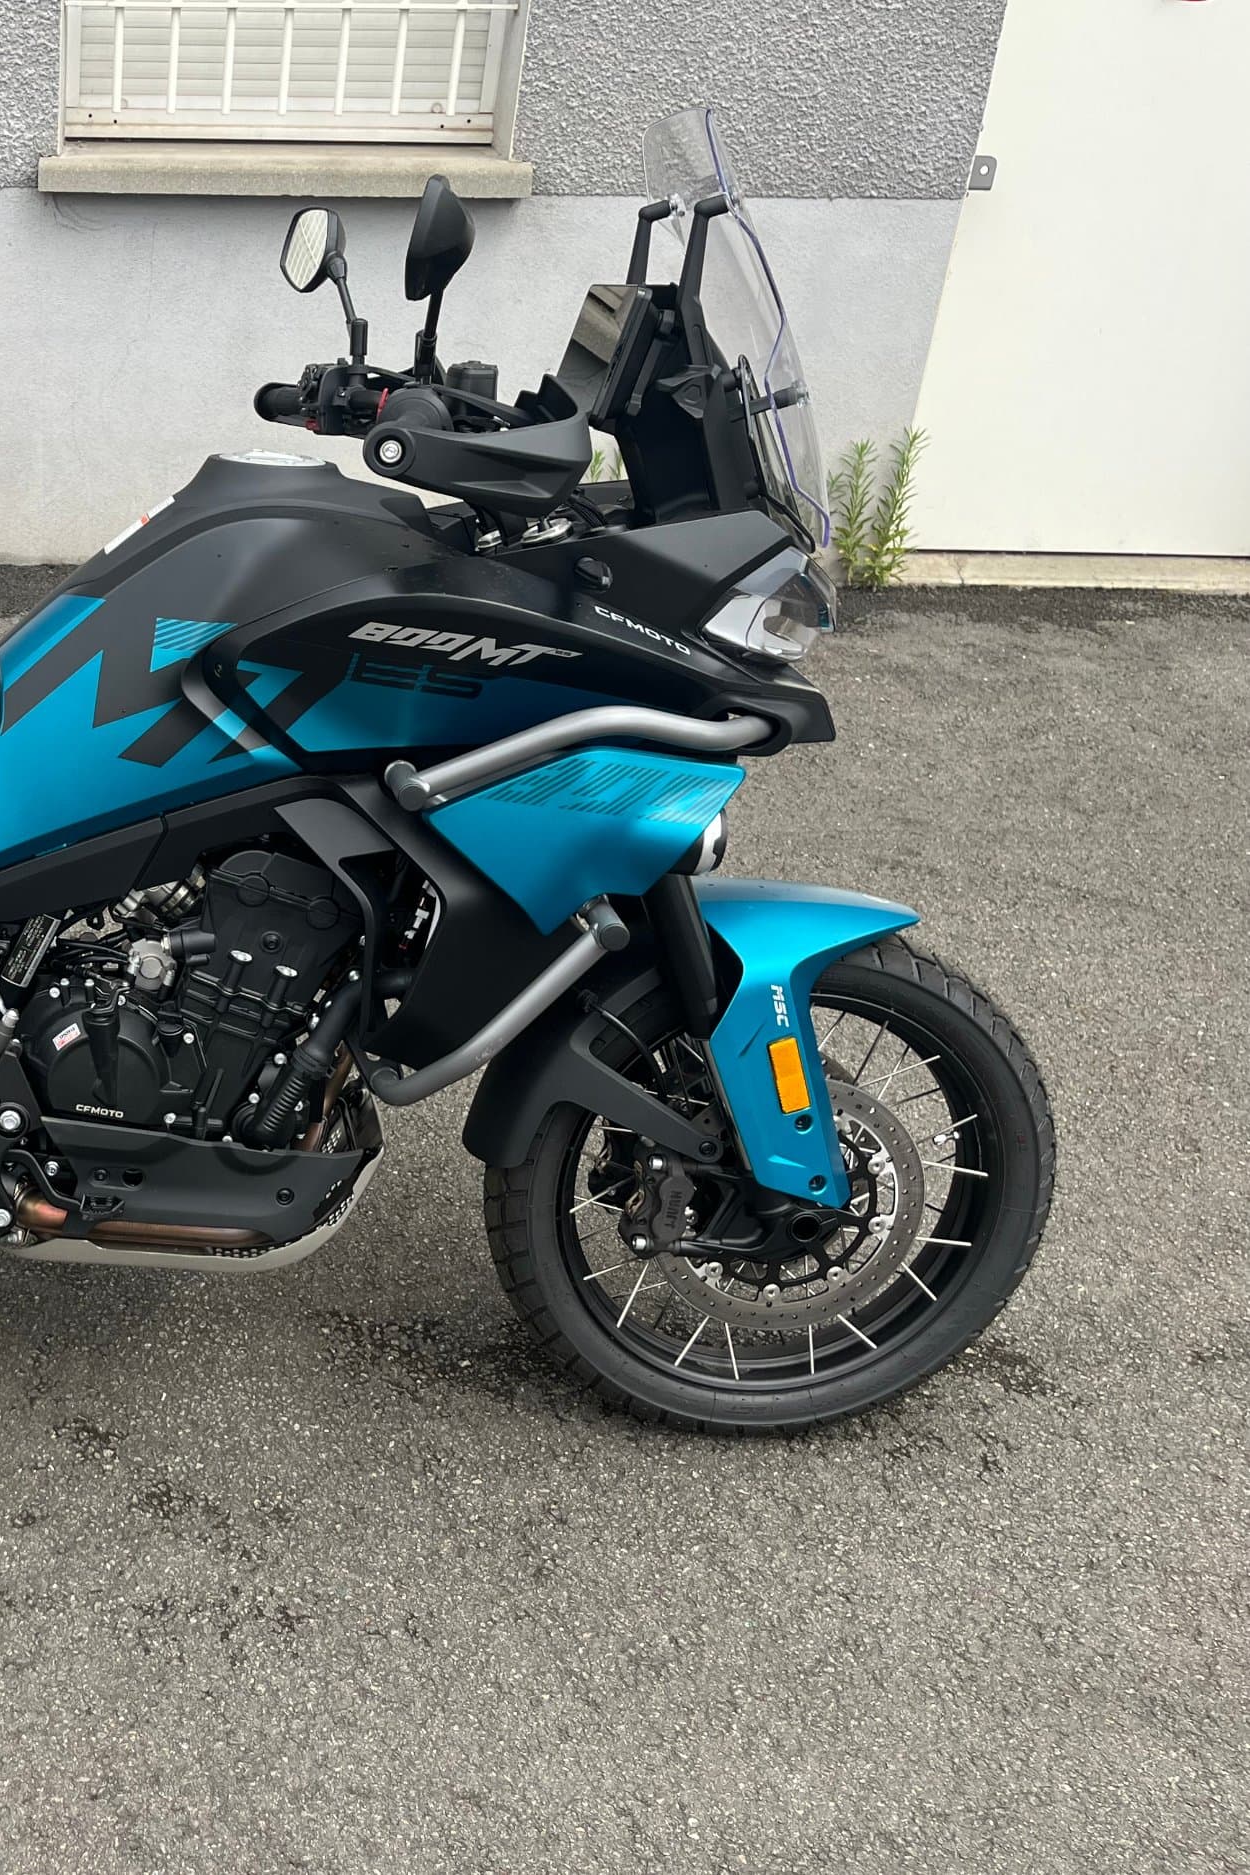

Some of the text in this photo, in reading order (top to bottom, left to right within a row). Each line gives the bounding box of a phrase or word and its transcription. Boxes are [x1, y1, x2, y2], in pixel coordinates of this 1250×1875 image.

[594, 605, 692, 656] CFMOTO
[770, 984, 790, 1028] MSC
[75, 1103, 124, 1119] CFMOTO
